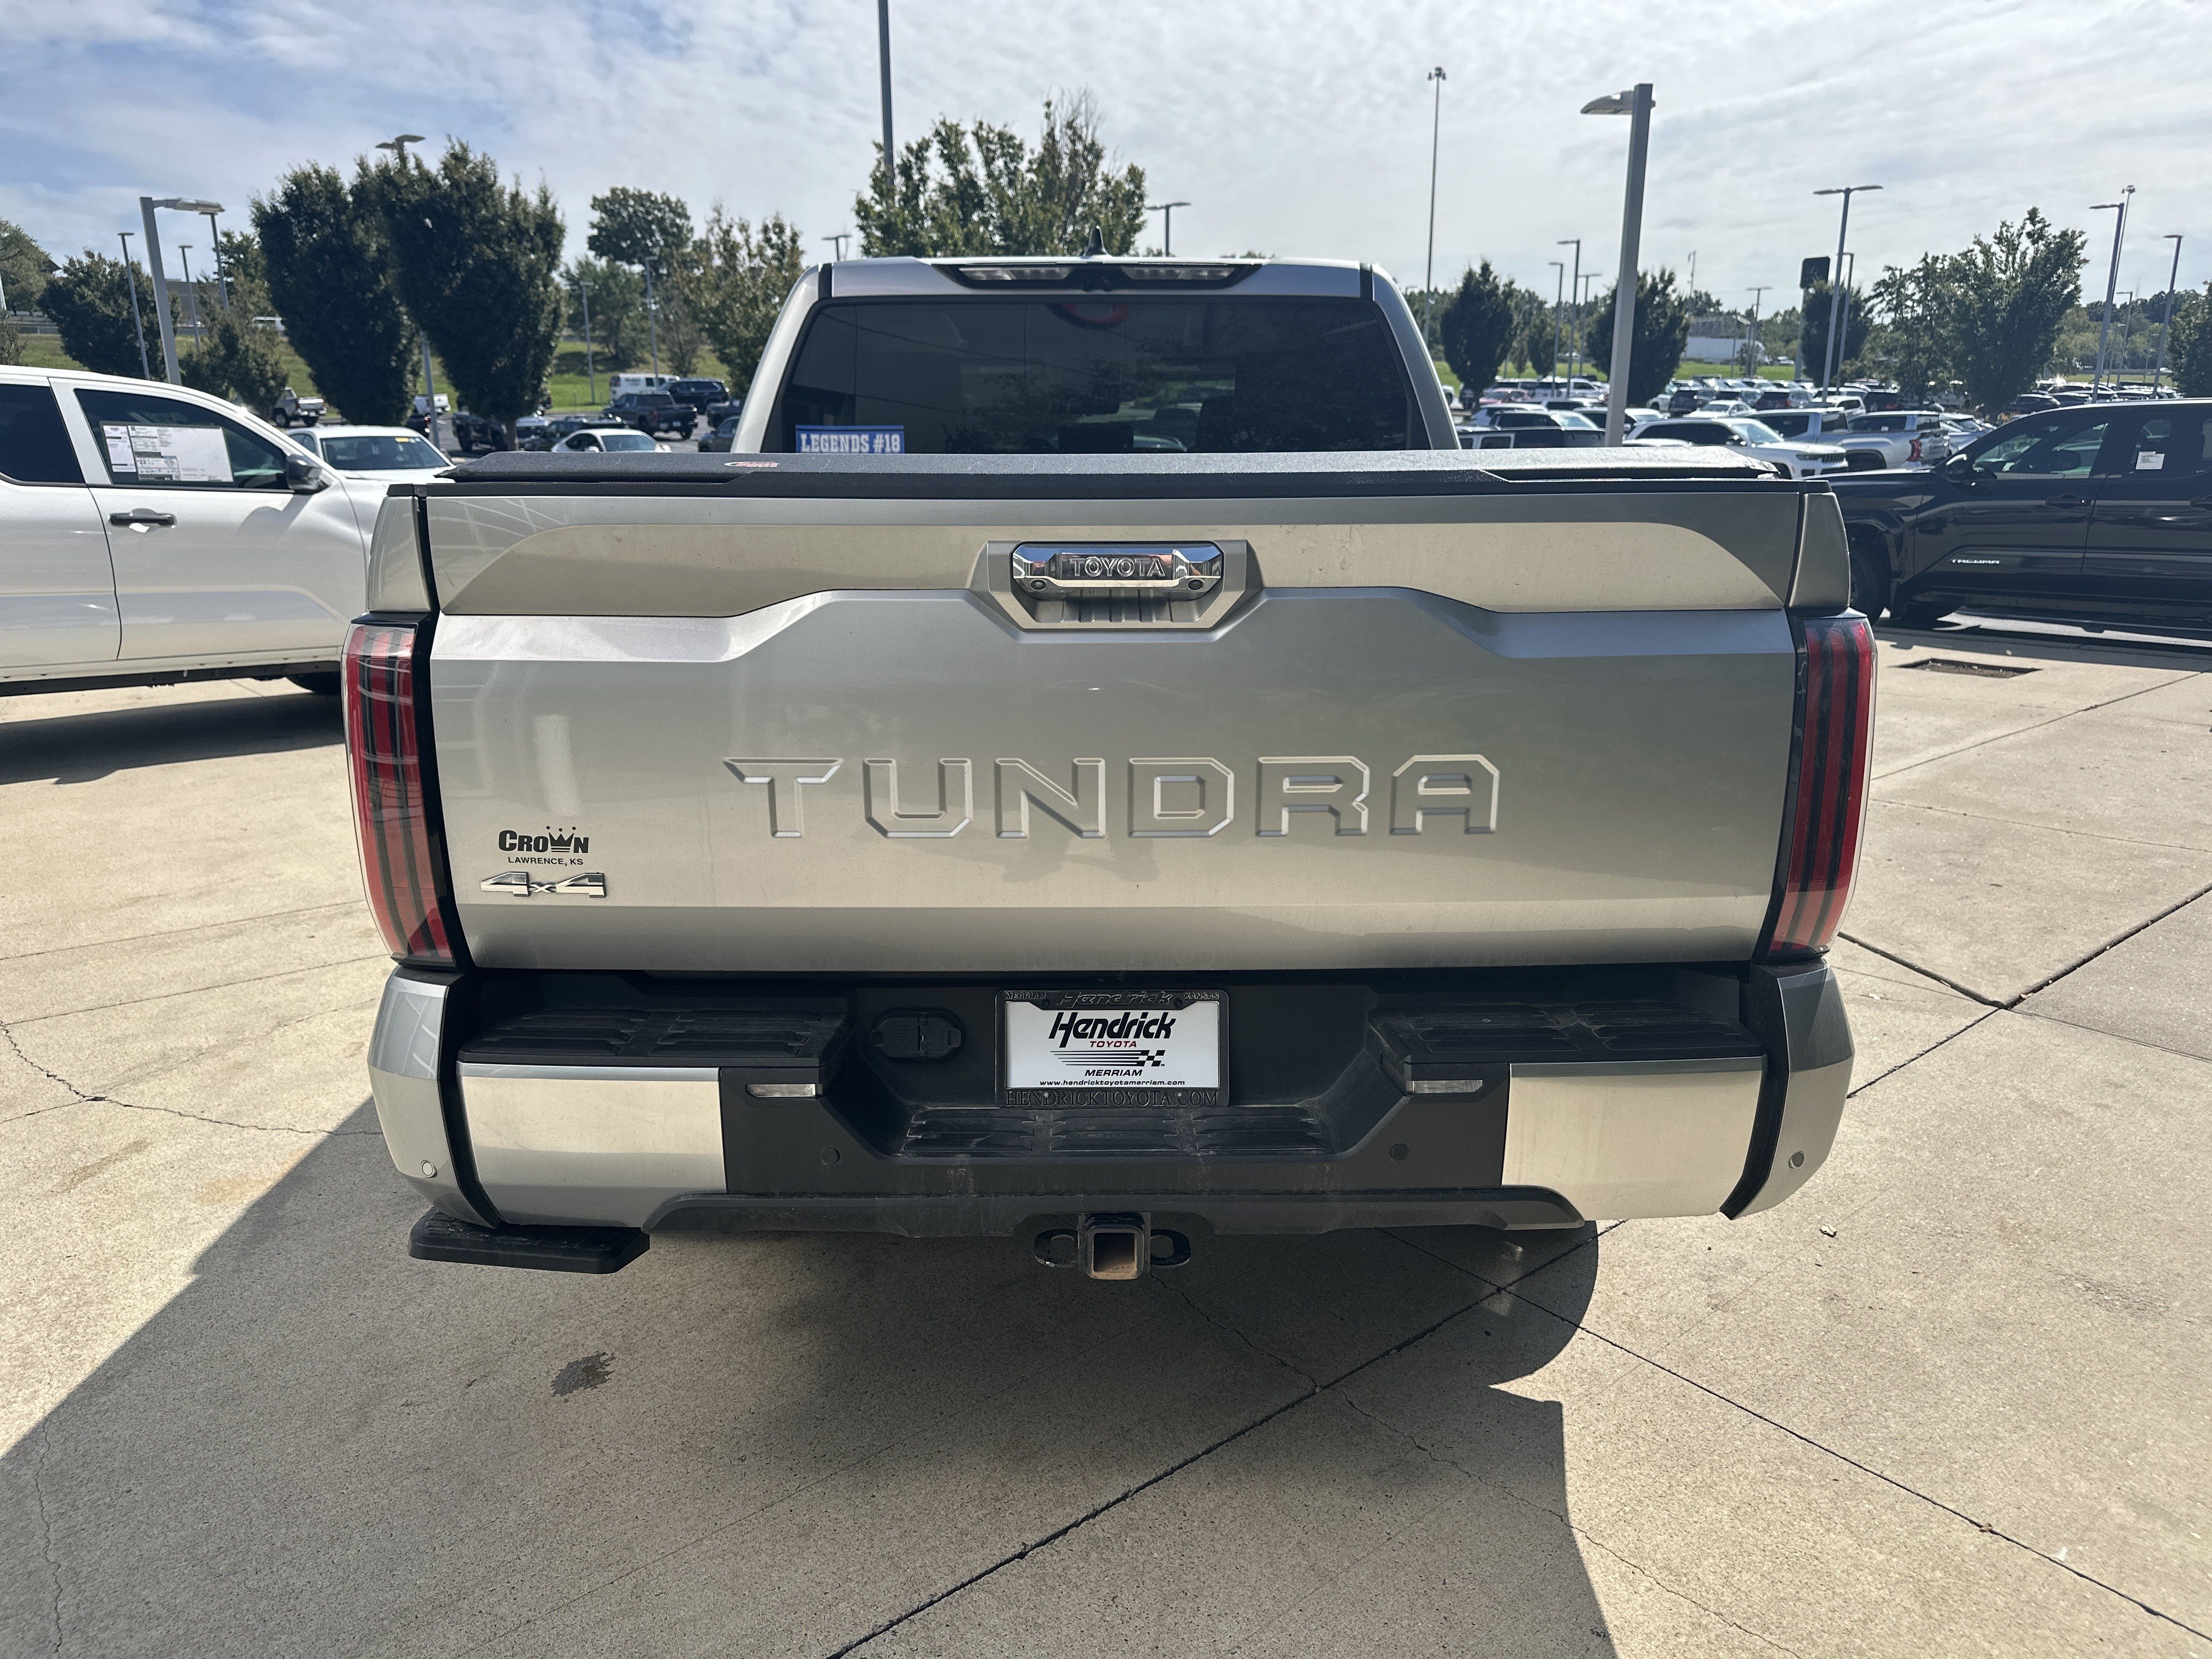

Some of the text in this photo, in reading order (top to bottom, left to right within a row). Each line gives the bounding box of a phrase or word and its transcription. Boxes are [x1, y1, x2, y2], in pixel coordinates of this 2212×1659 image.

[800, 433, 901, 453] LEGENDS #18
[1070, 556, 1165, 577] TOYOTA
[723, 754, 1501, 839] TUNDRA
[498, 826, 589, 854] CROWN
[508, 856, 567, 866] LAWRENCE,
[1005, 991, 1047, 1000] MERRIAM
[1056, 991, 1174, 1008] Hendrick
[1183, 991, 1220, 1000] KANSAS
[1048, 1012, 1176, 1048] Hendrick
[1005, 1091, 1219, 1107] HENDRICKTOYOTA.COM
